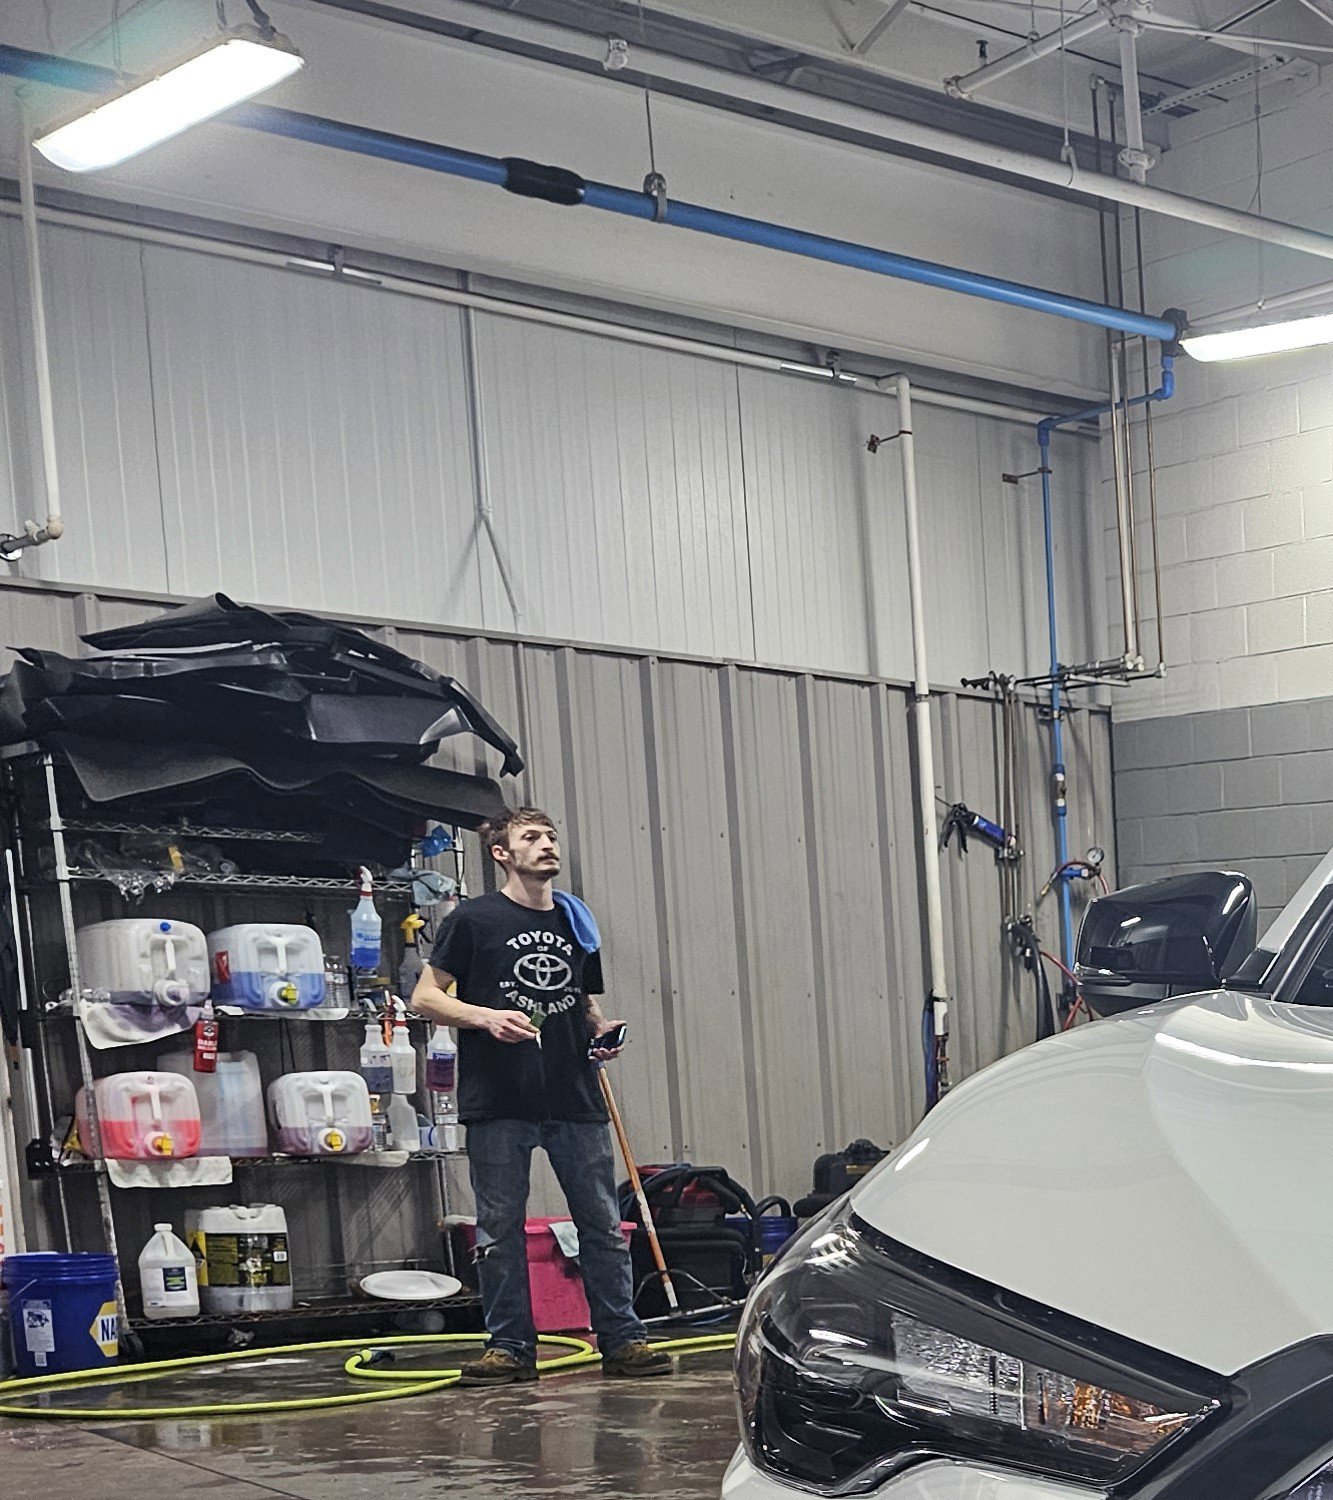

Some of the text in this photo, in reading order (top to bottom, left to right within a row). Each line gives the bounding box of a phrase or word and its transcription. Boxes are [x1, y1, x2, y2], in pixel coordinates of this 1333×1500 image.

[506, 930, 573, 956] TOYOTA
[505, 990, 576, 1015] ASHLAND
[100, 1317, 119, 1342] NA
